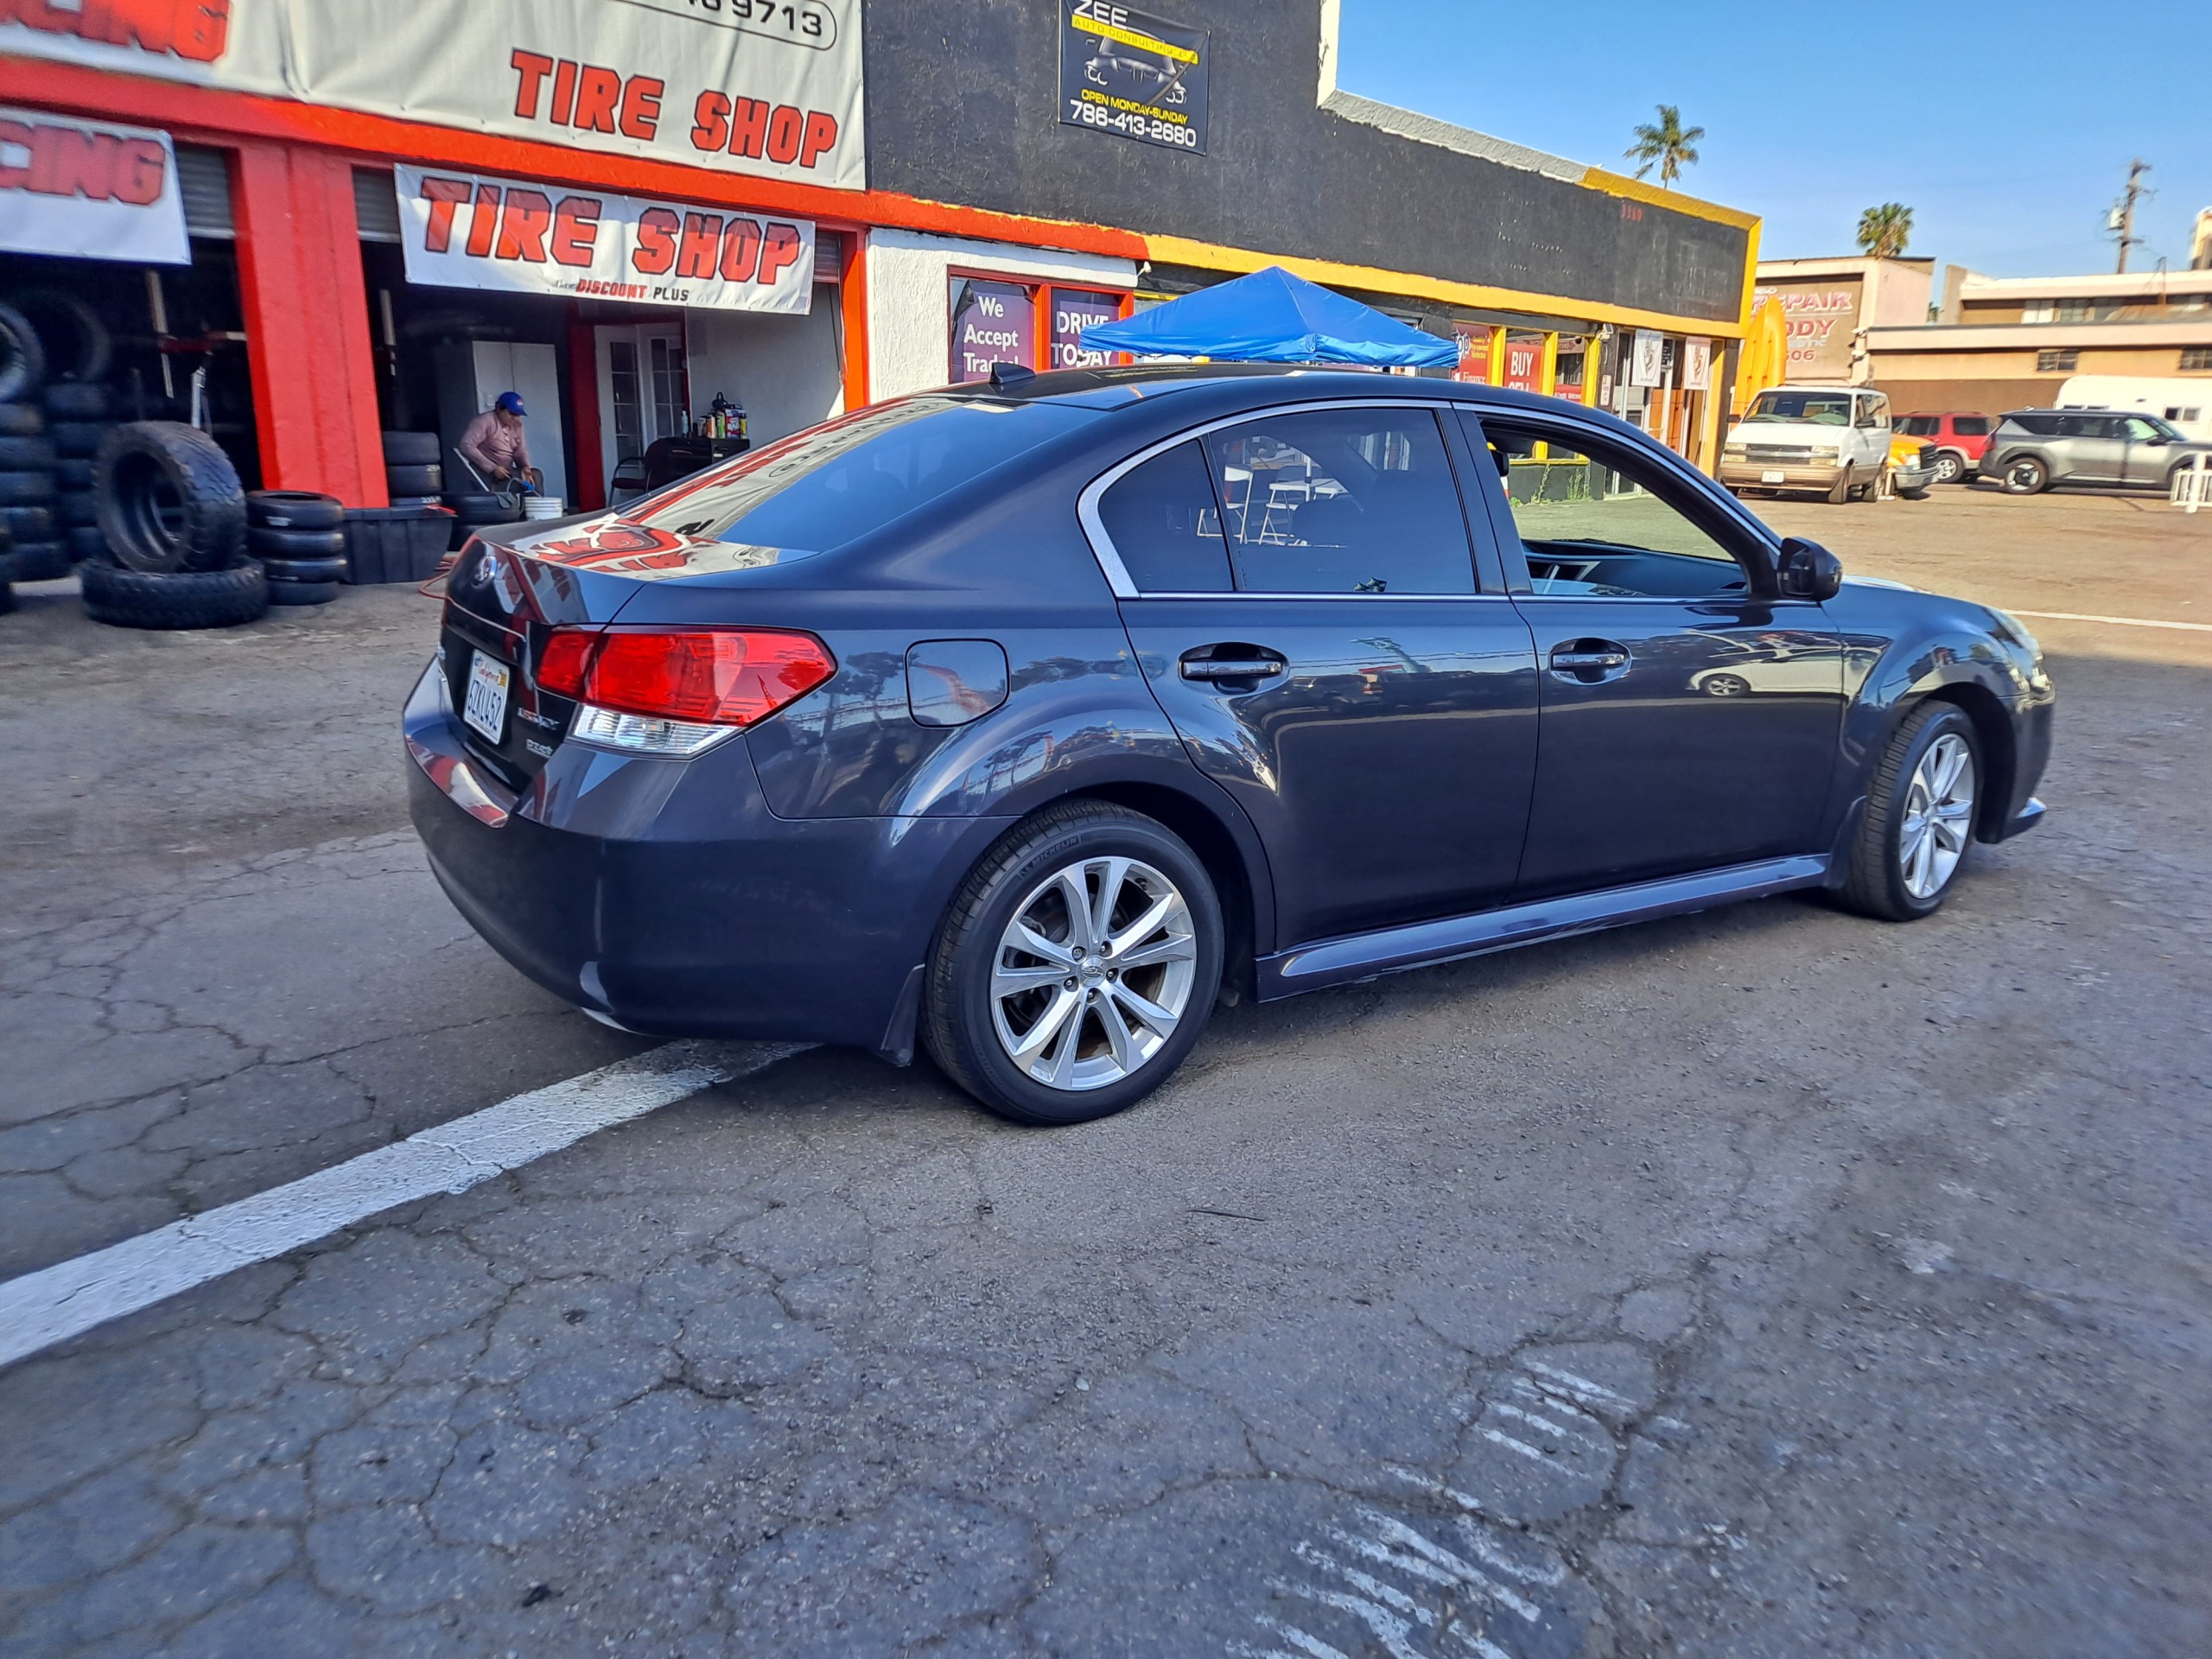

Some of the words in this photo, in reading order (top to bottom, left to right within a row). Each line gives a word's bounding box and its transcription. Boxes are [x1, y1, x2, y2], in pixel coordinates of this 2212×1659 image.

[1073, 0, 1128, 29] ZEE
[1074, 17, 1105, 34] AUTO
[511, 48, 664, 141] TIRE
[691, 89, 838, 168] SHOP
[1082, 89, 1109, 105] OPEN
[1110, 98, 1188, 124] MONDAY-SUNDAY
[1070, 99, 1197, 148] 786-413-2680
[421, 175, 602, 269] TIRE
[632, 207, 801, 286] SHOP
[575, 278, 648, 299] DISCOUNT
[652, 286, 690, 302] PLUS
[978, 296, 1004, 318] We
[963, 323, 1019, 352] Accept
[1510, 351, 1534, 377] BUY
